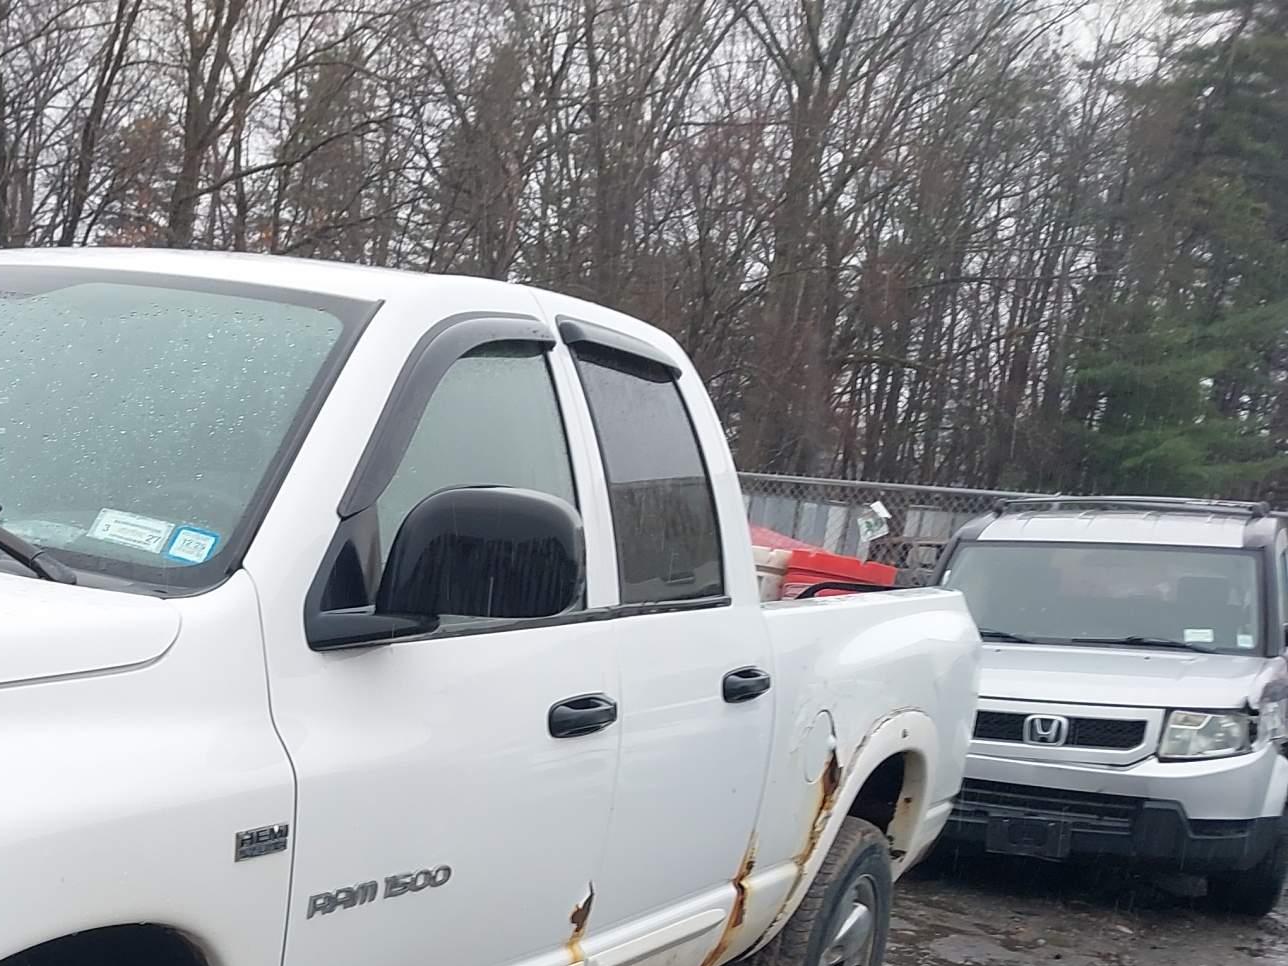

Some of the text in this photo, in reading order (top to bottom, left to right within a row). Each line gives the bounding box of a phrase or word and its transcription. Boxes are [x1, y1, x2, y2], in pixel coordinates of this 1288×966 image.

[145, 535, 161, 544] 27
[240, 824, 289, 848] HEMI
[306, 865, 452, 919] RAM 1500
